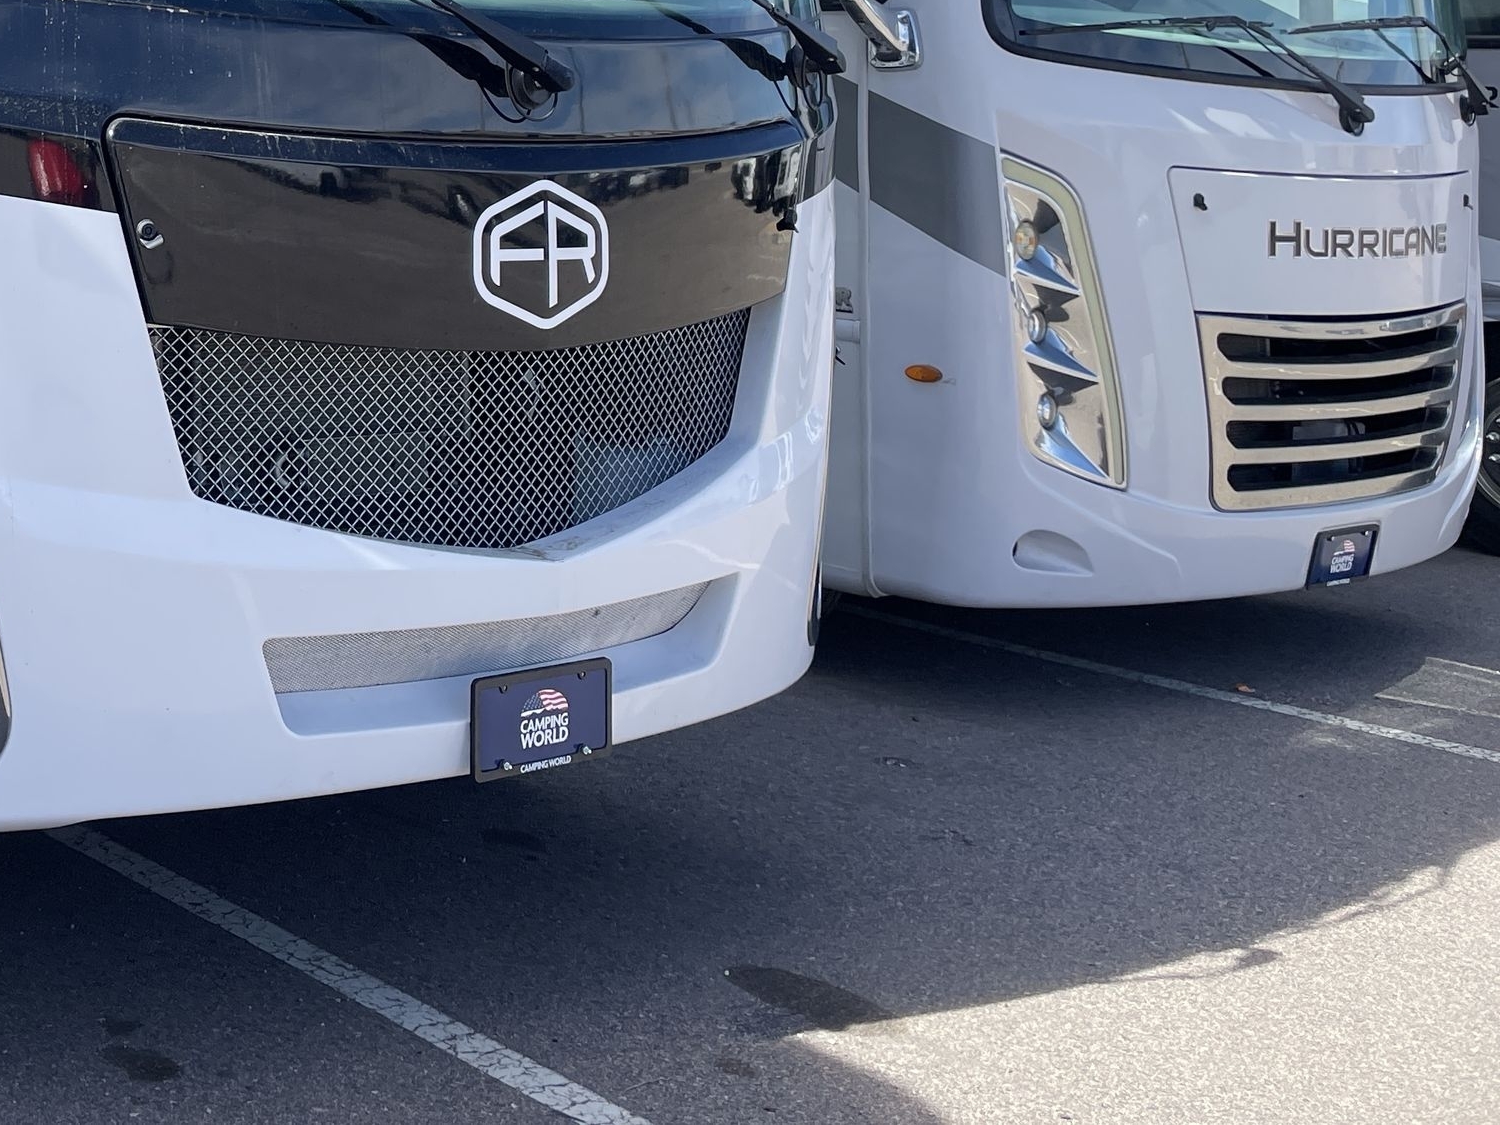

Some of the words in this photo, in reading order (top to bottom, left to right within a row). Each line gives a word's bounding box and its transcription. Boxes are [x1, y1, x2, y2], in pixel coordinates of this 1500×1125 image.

[1267, 219, 1447, 259] HURRICANE
[520, 712, 569, 734] CAMPING
[520, 726, 569, 750] WORLD
[520, 760, 548, 773] CAMPING
[548, 755, 572, 767] WORLD
